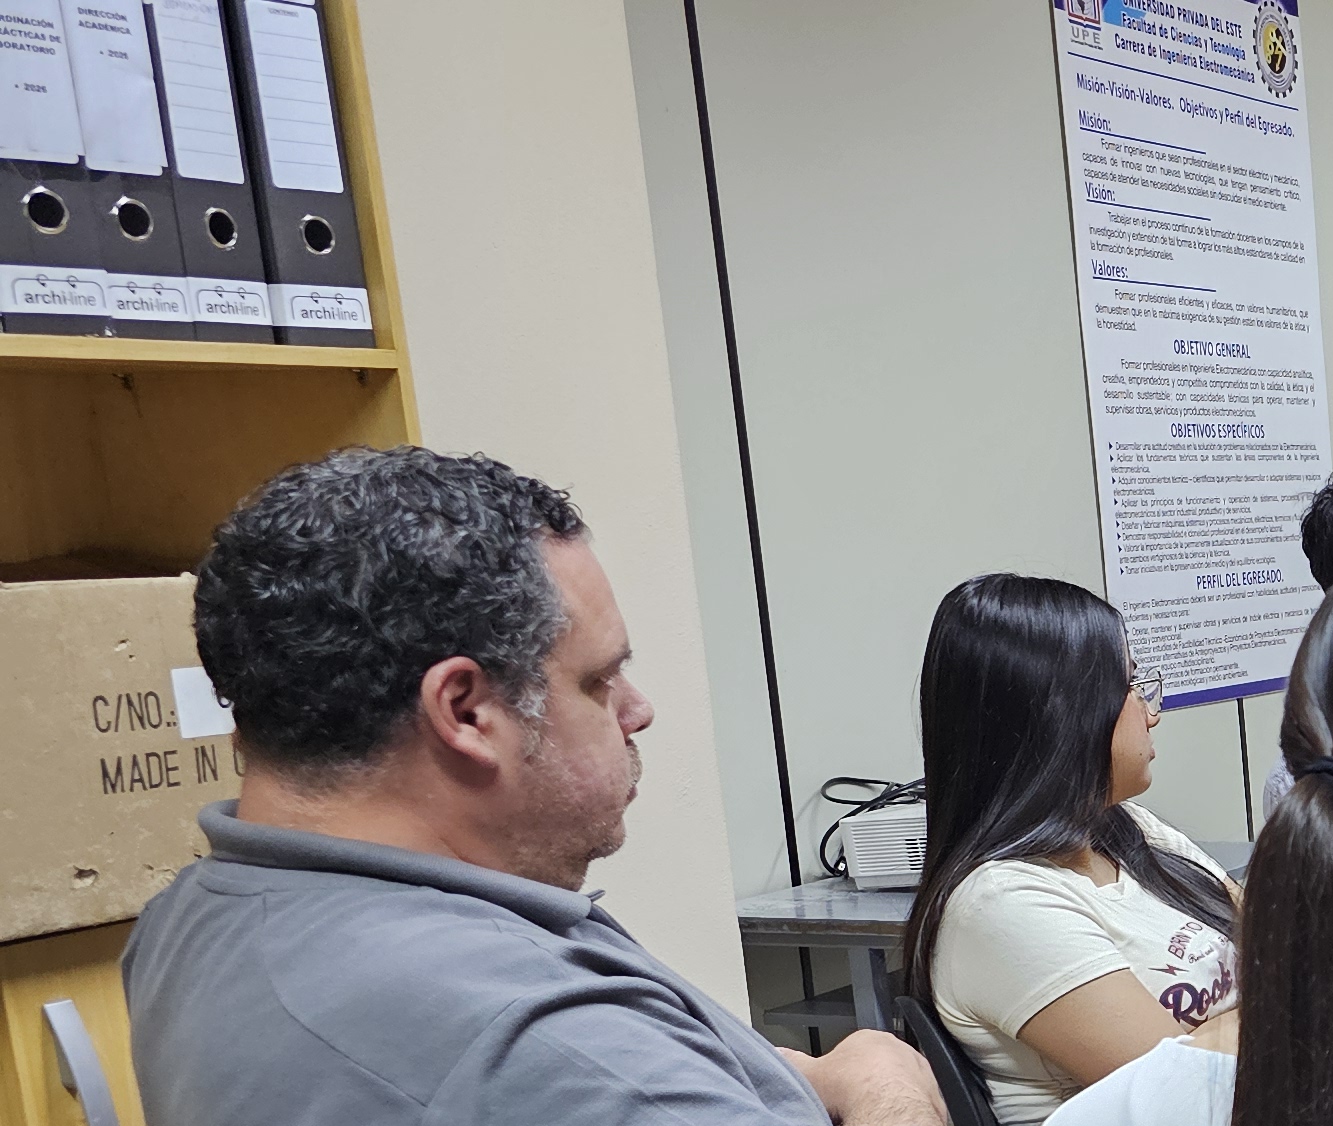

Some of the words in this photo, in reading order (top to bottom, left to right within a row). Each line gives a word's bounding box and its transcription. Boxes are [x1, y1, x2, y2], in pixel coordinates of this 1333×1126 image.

[1177, 7, 1209, 29] PRIVADA
[1211, 17, 1224, 33] DEL
[1225, 21, 1242, 39] ESTE
[1071, 26, 1101, 44] UPE
[1122, 12, 1156, 35] Facultad
[1159, 24, 1168, 39] de
[1171, 26, 1202, 48] Ciencias
[1204, 39, 1208, 52] y
[1209, 37, 1246, 62] Tecnología
[1114, 33, 1145, 55] Carrera
[1147, 42, 1157, 57] de
[1159, 45, 1197, 68] Ingeniería
[1199, 55, 1255, 83] Electromecánica
[1076, 73, 1174, 110] Misión-Visión-Valores.
[1179, 97, 1218, 120] Objetivos
[1219, 110, 1224, 124] y
[1225, 107, 1244, 126] Perfil
[1245, 113, 1257, 129] del
[1258, 115, 1294, 138] Egresado.
[1078, 109, 1111, 131] Misión:
[1085, 181, 1115, 201] Visión:
[1091, 259, 1128, 278] Valores:
[1173, 339, 1213, 356] OBJETIVO
[1215, 342, 1251, 358] GENERAL
[1170, 423, 1216, 438] OBJETIVOS
[1217, 421, 1265, 439] ESPECÍFICOS
[1196, 575, 1224, 590] PERFIL
[1226, 572, 1242, 587] DEL
[1242, 568, 1284, 586] EGRESADO.
[100, 750, 181, 794] MADE
[194, 744, 218, 784] IN
